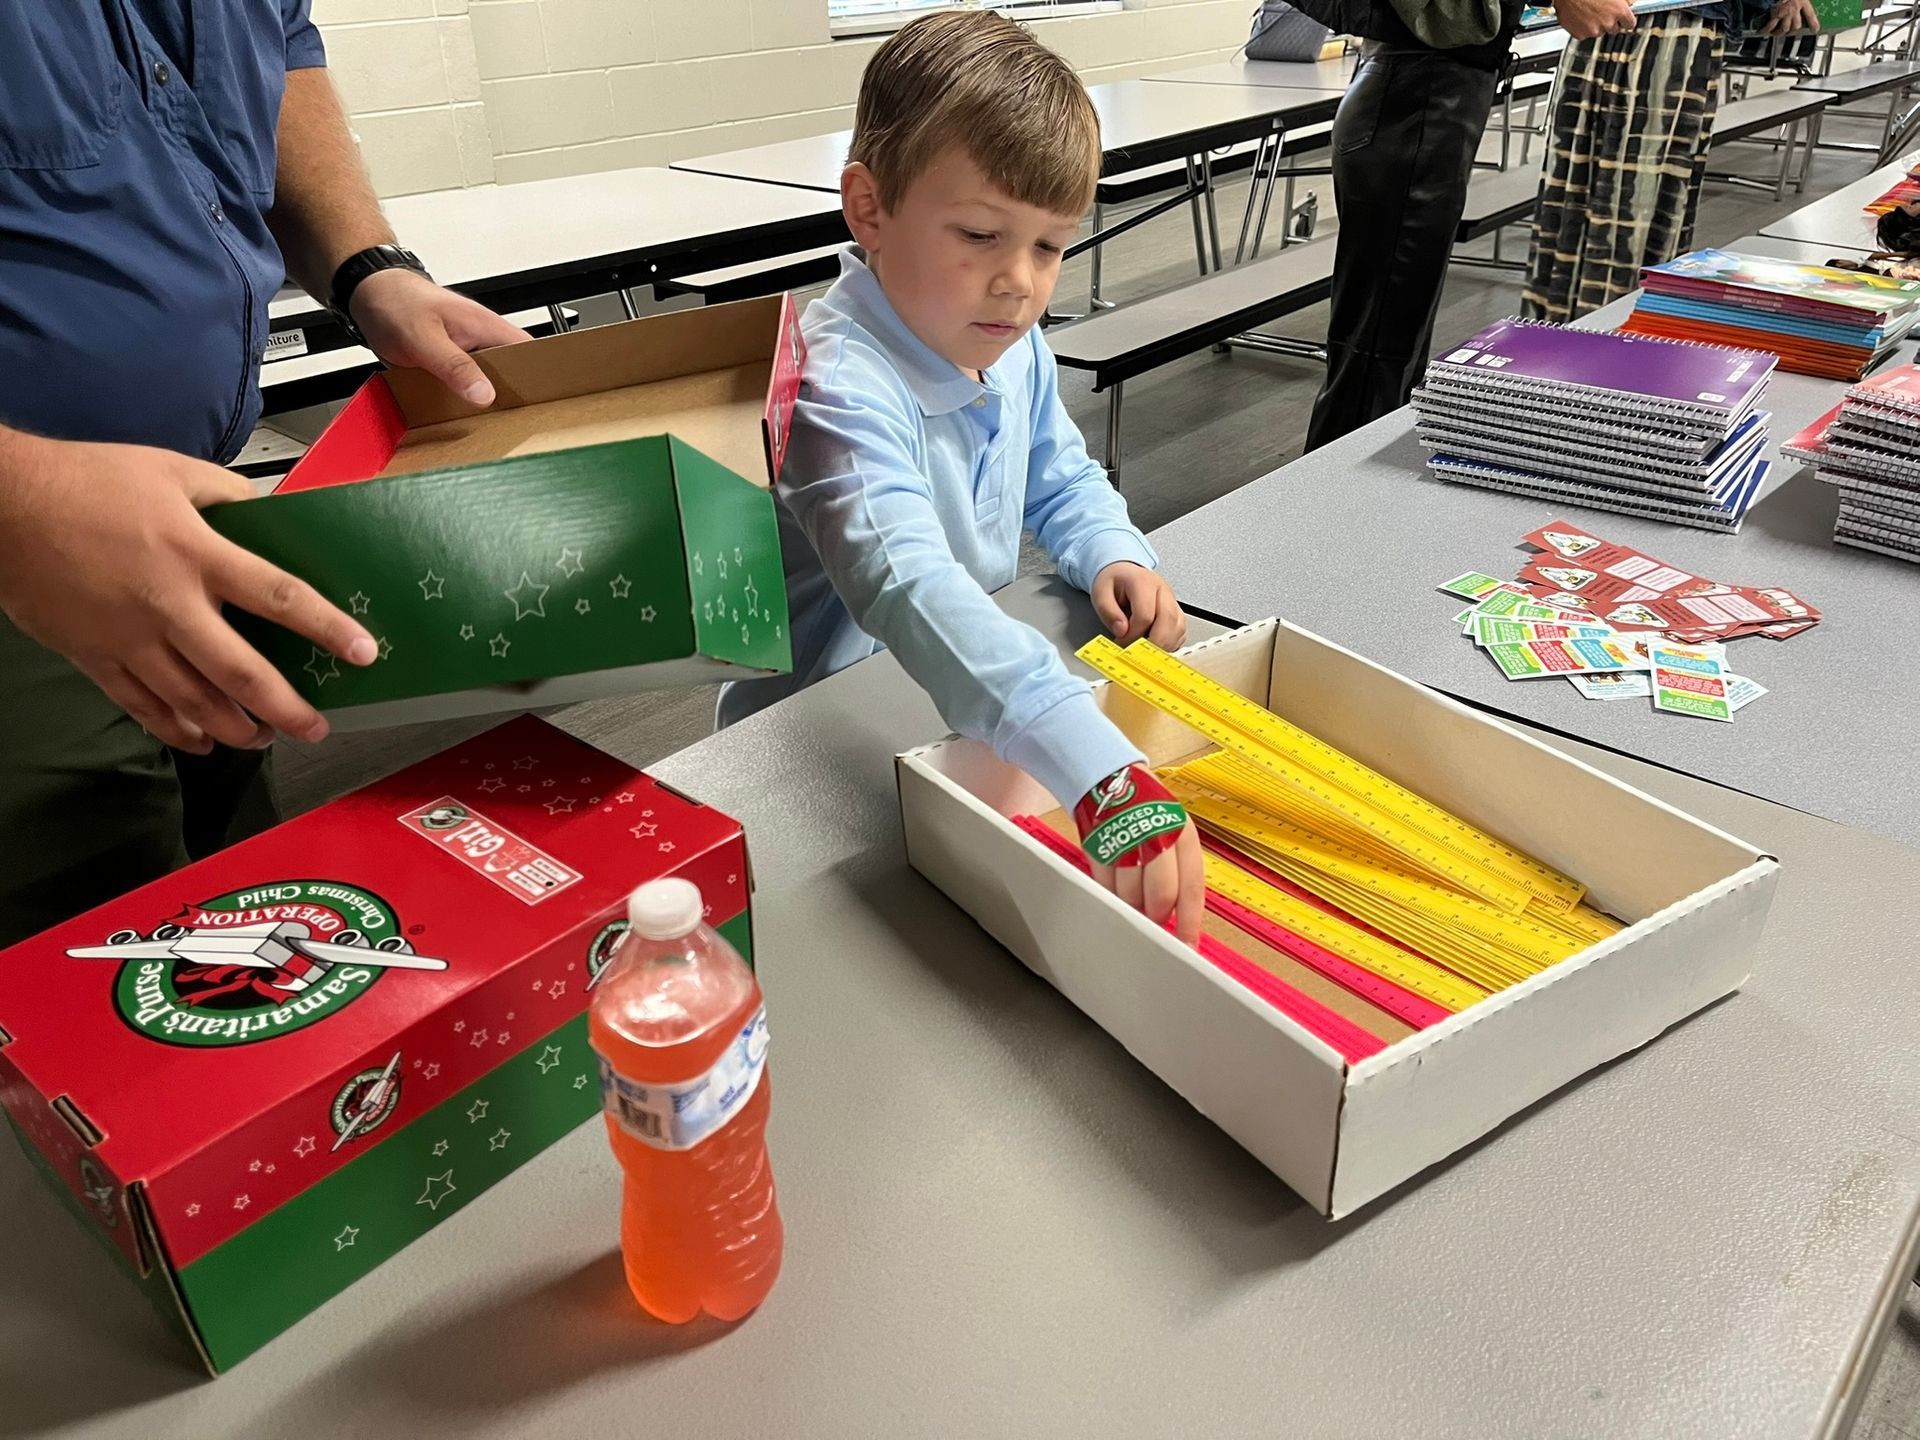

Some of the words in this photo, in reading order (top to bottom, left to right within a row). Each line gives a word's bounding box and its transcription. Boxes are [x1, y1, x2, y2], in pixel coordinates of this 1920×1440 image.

[442, 820, 506, 857] Girl
[1098, 813, 1182, 859] SHOEBOX!
[1104, 807, 1153, 836] PACKED
[1157, 805, 1167, 813] A
[237, 884, 302, 909] Child
[307, 885, 386, 930] Christmas
[193, 906, 342, 933] OPERATION
[134, 962, 172, 1027] Purse
[163, 966, 373, 1039] Samaritan's
